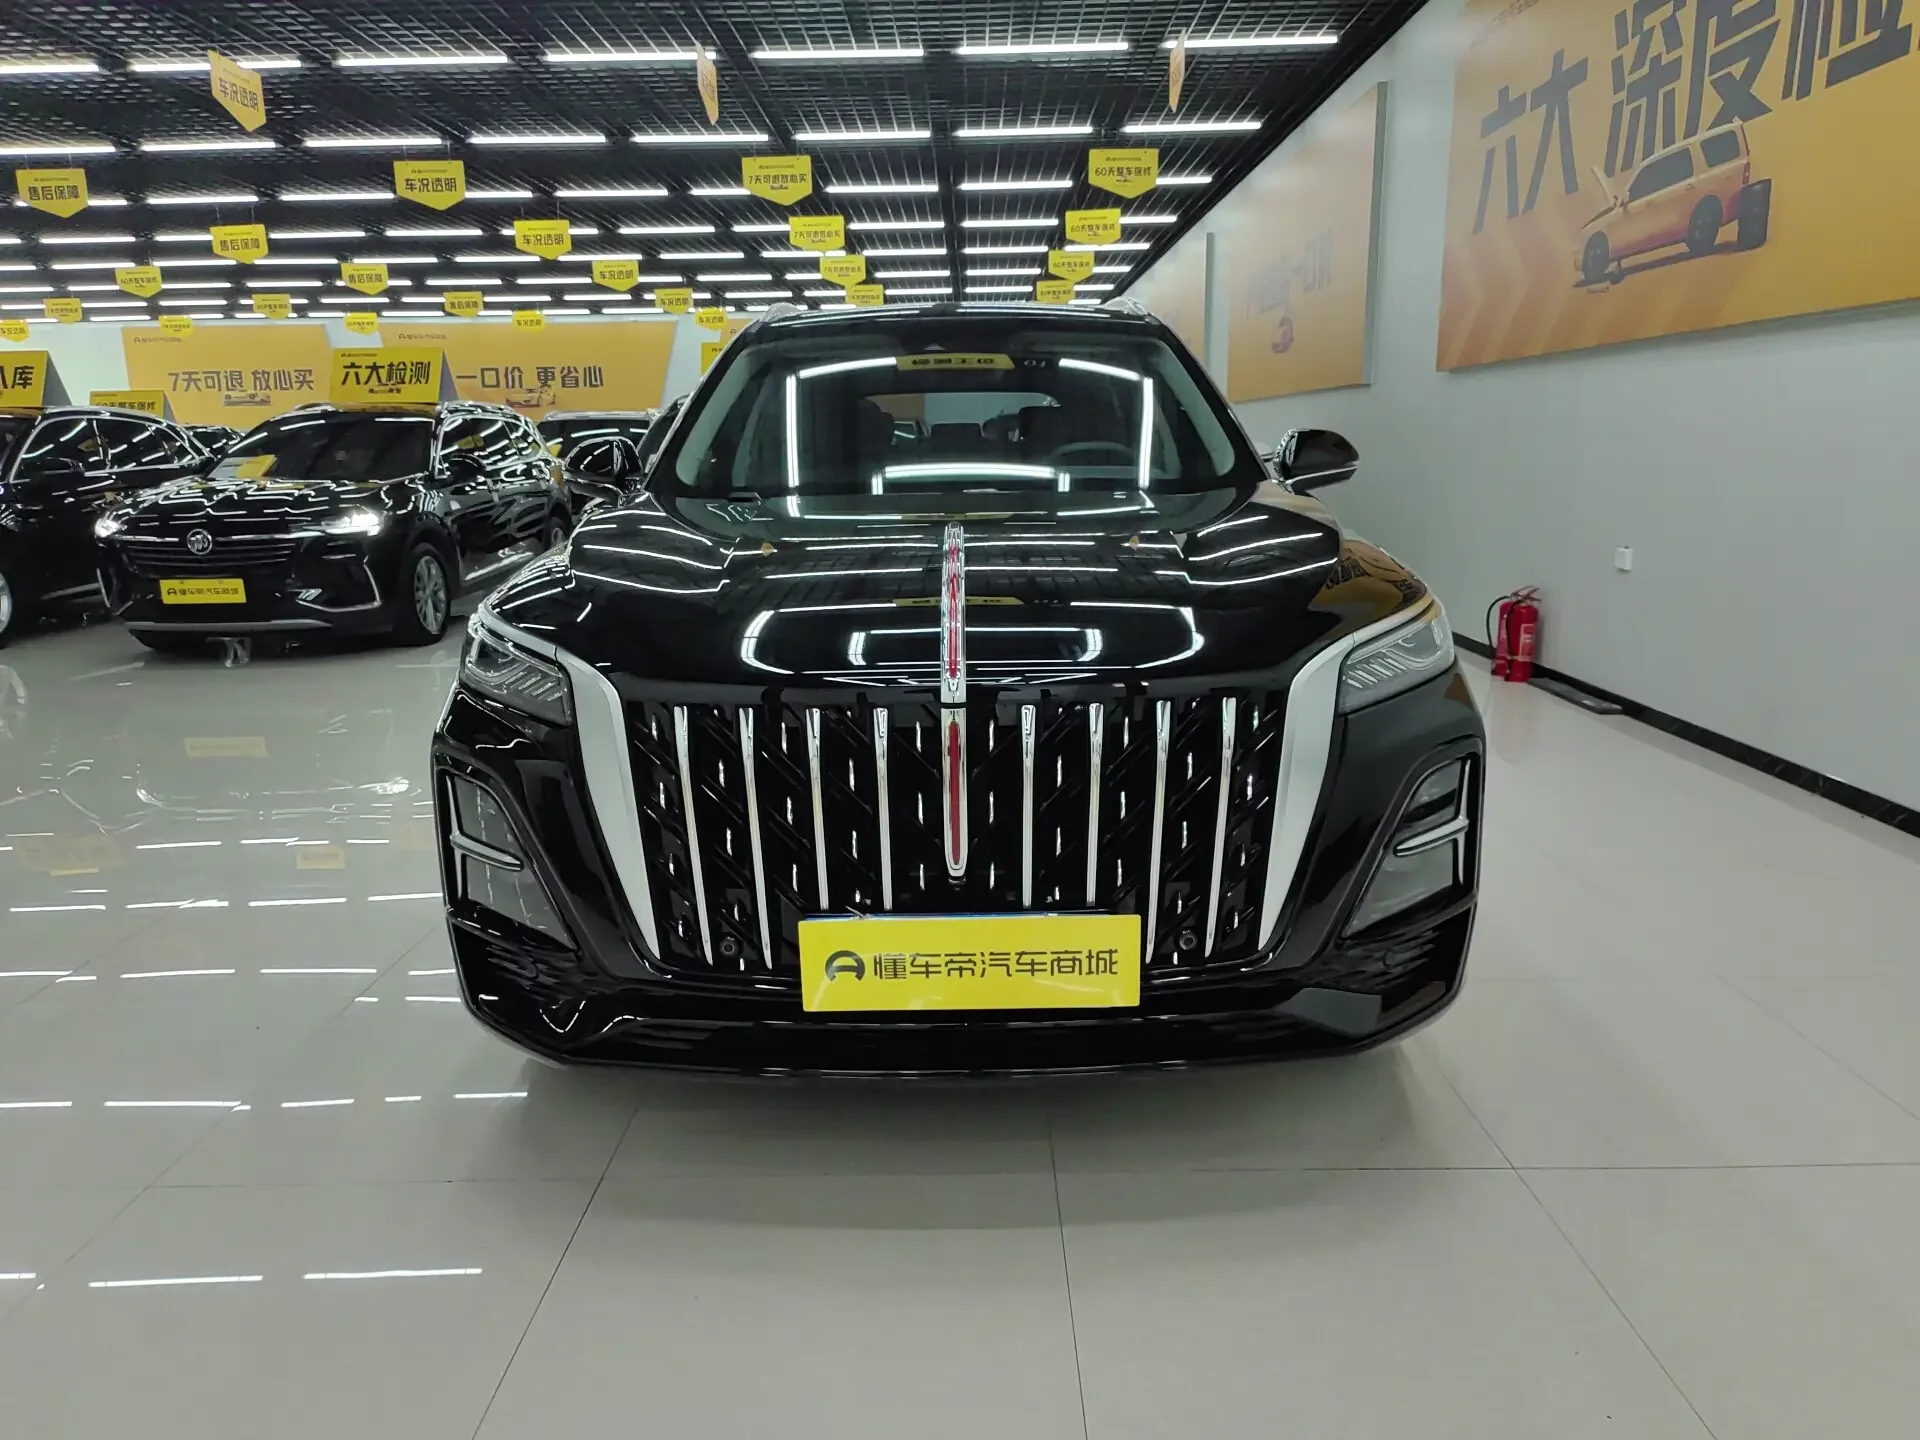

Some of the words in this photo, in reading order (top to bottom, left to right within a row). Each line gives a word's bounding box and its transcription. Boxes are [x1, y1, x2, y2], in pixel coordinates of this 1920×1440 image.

[218, 77, 260, 112] 车况透明
[748, 173, 807, 185] 7天可退放心买
[1094, 166, 1152, 177] 60天整车保修
[28, 185, 80, 201] 售后保障
[404, 177, 457, 193] 车况透明
[219, 238, 261, 252] 售后保障
[522, 233, 565, 246] 车况透明
[599, 269, 634, 280] 车况透明
[168, 369, 244, 393] 7天可退
[252, 368, 316, 391] 放心买
[341, 360, 431, 387] 六大检测
[456, 365, 524, 389] 一口价
[535, 365, 605, 389] 更省心
[873, 948, 1119, 981] 懂车帝汽车商城
